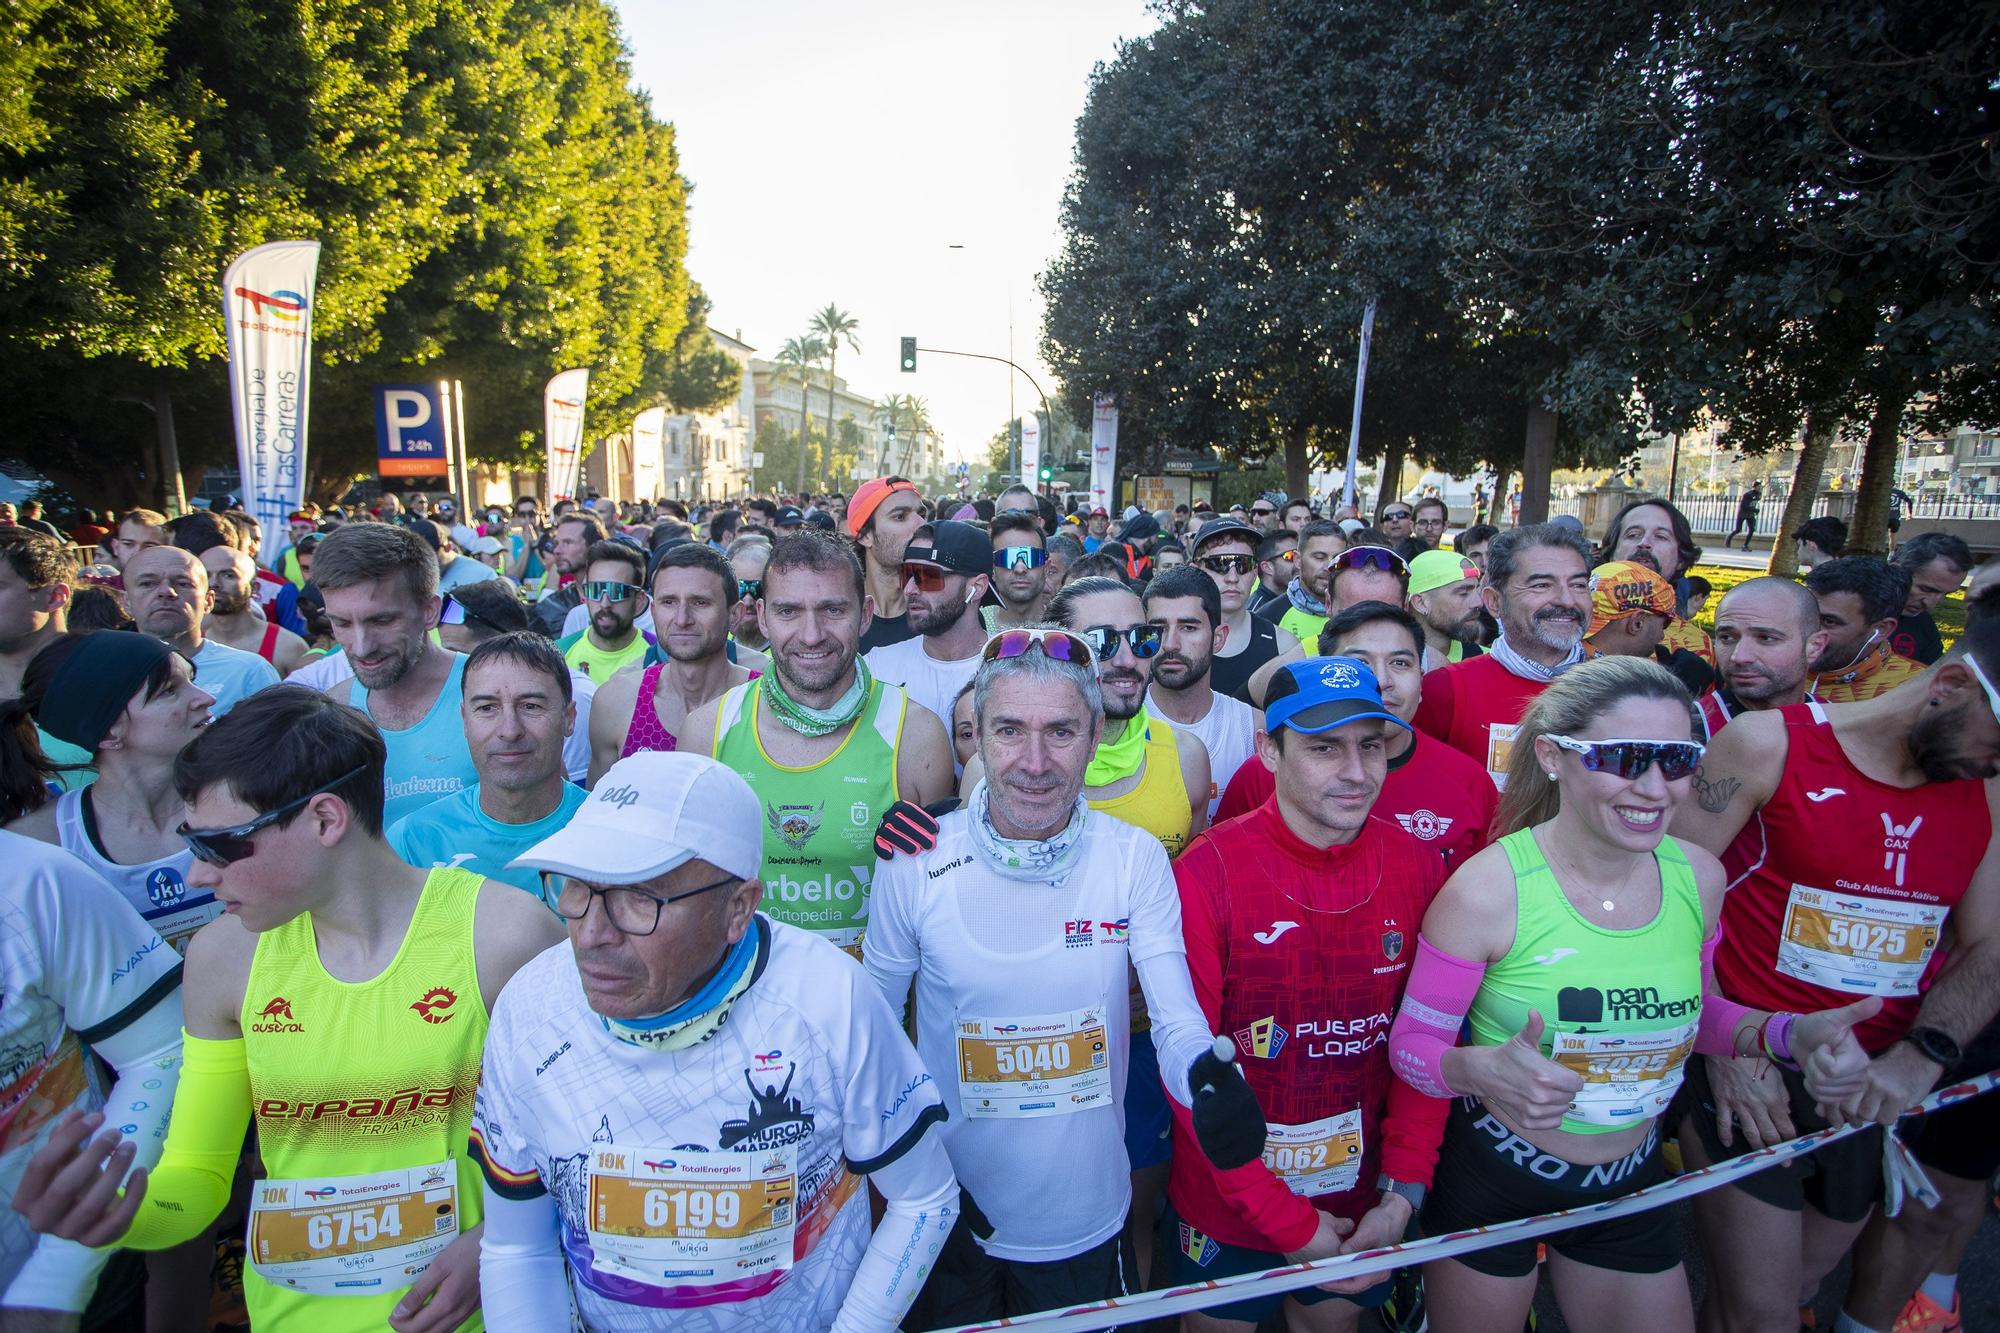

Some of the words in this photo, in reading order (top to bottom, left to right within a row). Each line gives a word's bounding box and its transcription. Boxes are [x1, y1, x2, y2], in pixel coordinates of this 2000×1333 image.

[273, 369, 297, 488] LasCarreras
[384, 390, 431, 452] P
[406, 439, 433, 452] 24h
[1614, 581, 1652, 600] CORRE
[600, 784, 640, 809] edp
[1884, 838, 1909, 850] CAX
[928, 858, 961, 879] luanvi
[762, 873, 855, 902] rbelo
[1835, 879, 1860, 891] Club
[1862, 884, 1909, 899] Atletisme
[1798, 892, 1821, 904] 10K
[769, 906, 842, 925] Ortopedia
[1864, 906, 1909, 918] TotalEnergies
[1828, 918, 1906, 955] 5025
[1373, 965, 1395, 975] PUERTAS
[1606, 987, 1659, 1010] pan
[1613, 994, 1700, 1021] moreno
[961, 1023, 981, 1034] 10K
[1021, 1023, 1066, 1033] TotalEnergies
[1295, 1008, 1394, 1038] PUERTA
[1308, 1031, 1388, 1058] LORCA
[1562, 1038, 1587, 1049] 10K
[1628, 1038, 1672, 1046] TotalEnergies
[536, 1041, 572, 1077] ARGIUS
[996, 1042, 1071, 1074] 5040
[1076, 1093, 1100, 1104] soltec
[361, 1111, 448, 1135] TRIATLÓN
[748, 1122, 813, 1144] MURCIA
[1287, 1128, 1327, 1138] TotalEnergies
[1262, 1144, 1328, 1170] 5062
[1473, 1113, 1570, 1180] PRO
[1580, 1129, 1657, 1188] NIKE
[598, 1152, 626, 1170] 10K
[680, 1164, 742, 1175] TotalEnergies
[340, 1183, 401, 1196] TotalEnergies
[1322, 1180, 1345, 1189] soltec
[262, 1187, 289, 1204] 10K
[643, 1188, 740, 1229] 6199
[308, 1204, 403, 1250] 6754
[677, 1227, 706, 1237] Milton
[411, 1263, 431, 1275] sol
[743, 1254, 777, 1269] soltec
